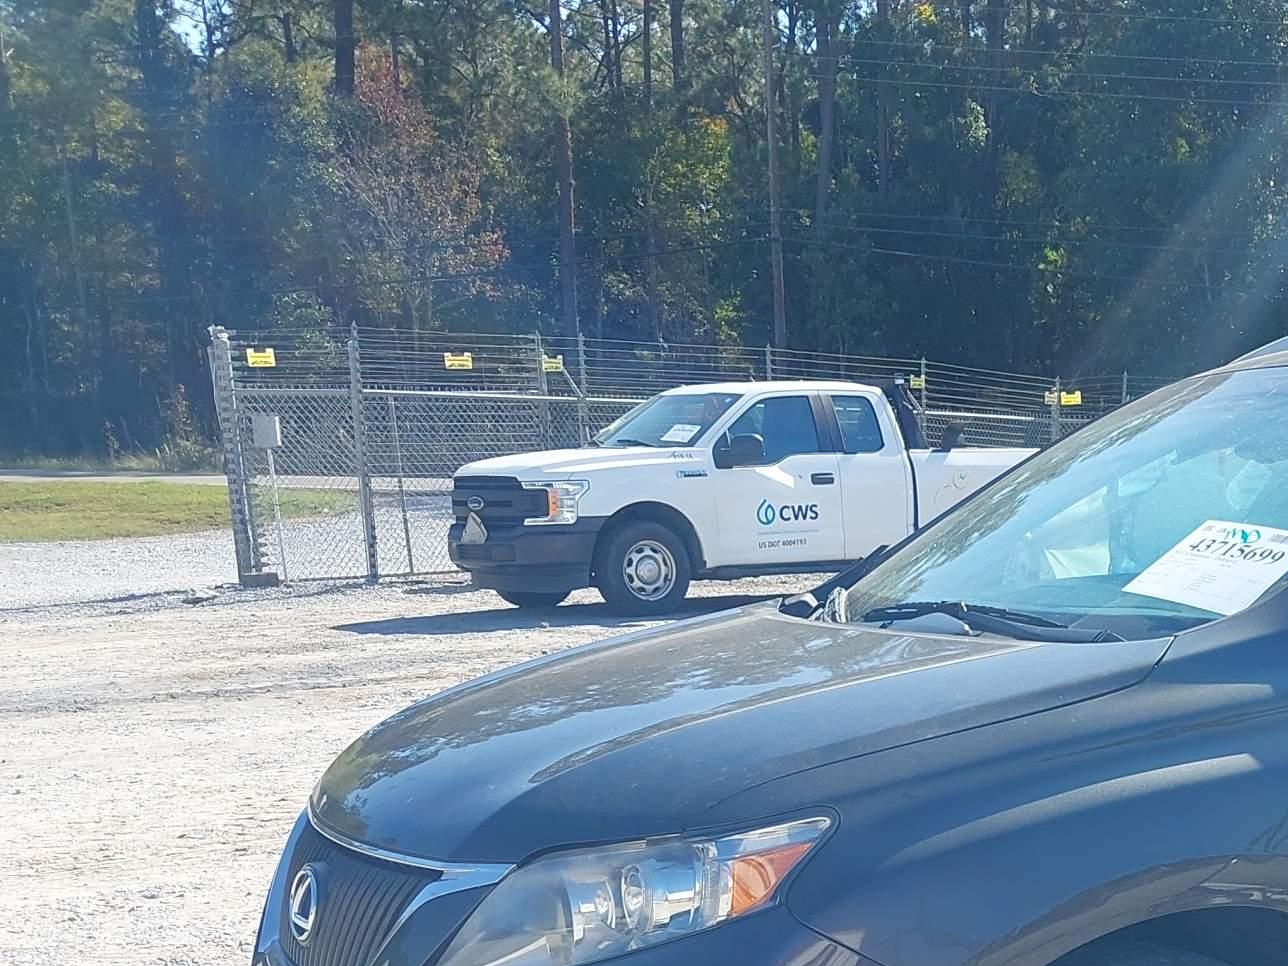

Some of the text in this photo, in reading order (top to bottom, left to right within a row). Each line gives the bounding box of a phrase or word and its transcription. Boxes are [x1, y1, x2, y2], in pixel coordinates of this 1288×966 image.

[779, 504, 819, 522] CWS
[758, 541, 767, 549] US
[768, 540, 781, 548] DOT
[1189, 538, 1286, 565] 43715699
